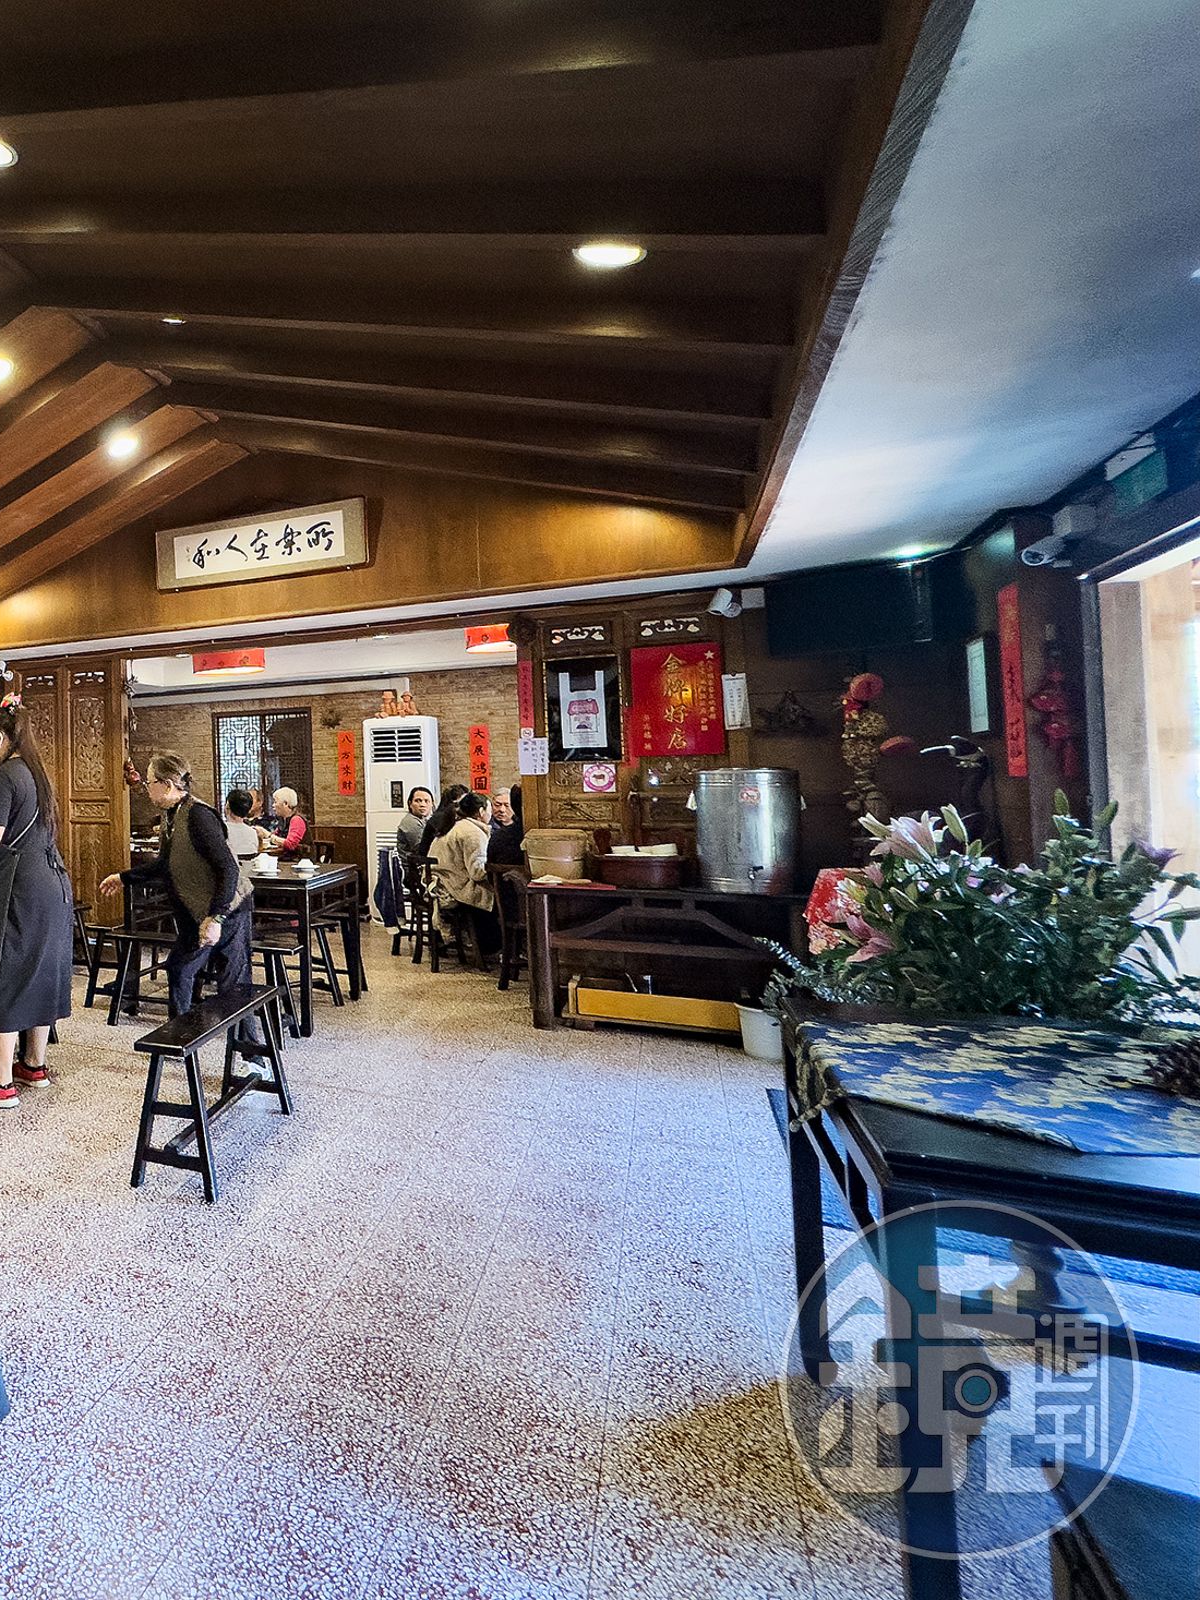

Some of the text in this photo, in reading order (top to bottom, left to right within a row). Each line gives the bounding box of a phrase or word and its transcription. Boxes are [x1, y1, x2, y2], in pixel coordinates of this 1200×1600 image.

[661, 652, 688, 750] 金牌好店
[341, 734, 353, 790] 八方來財
[472, 728, 488, 790] 大展鴻圖
